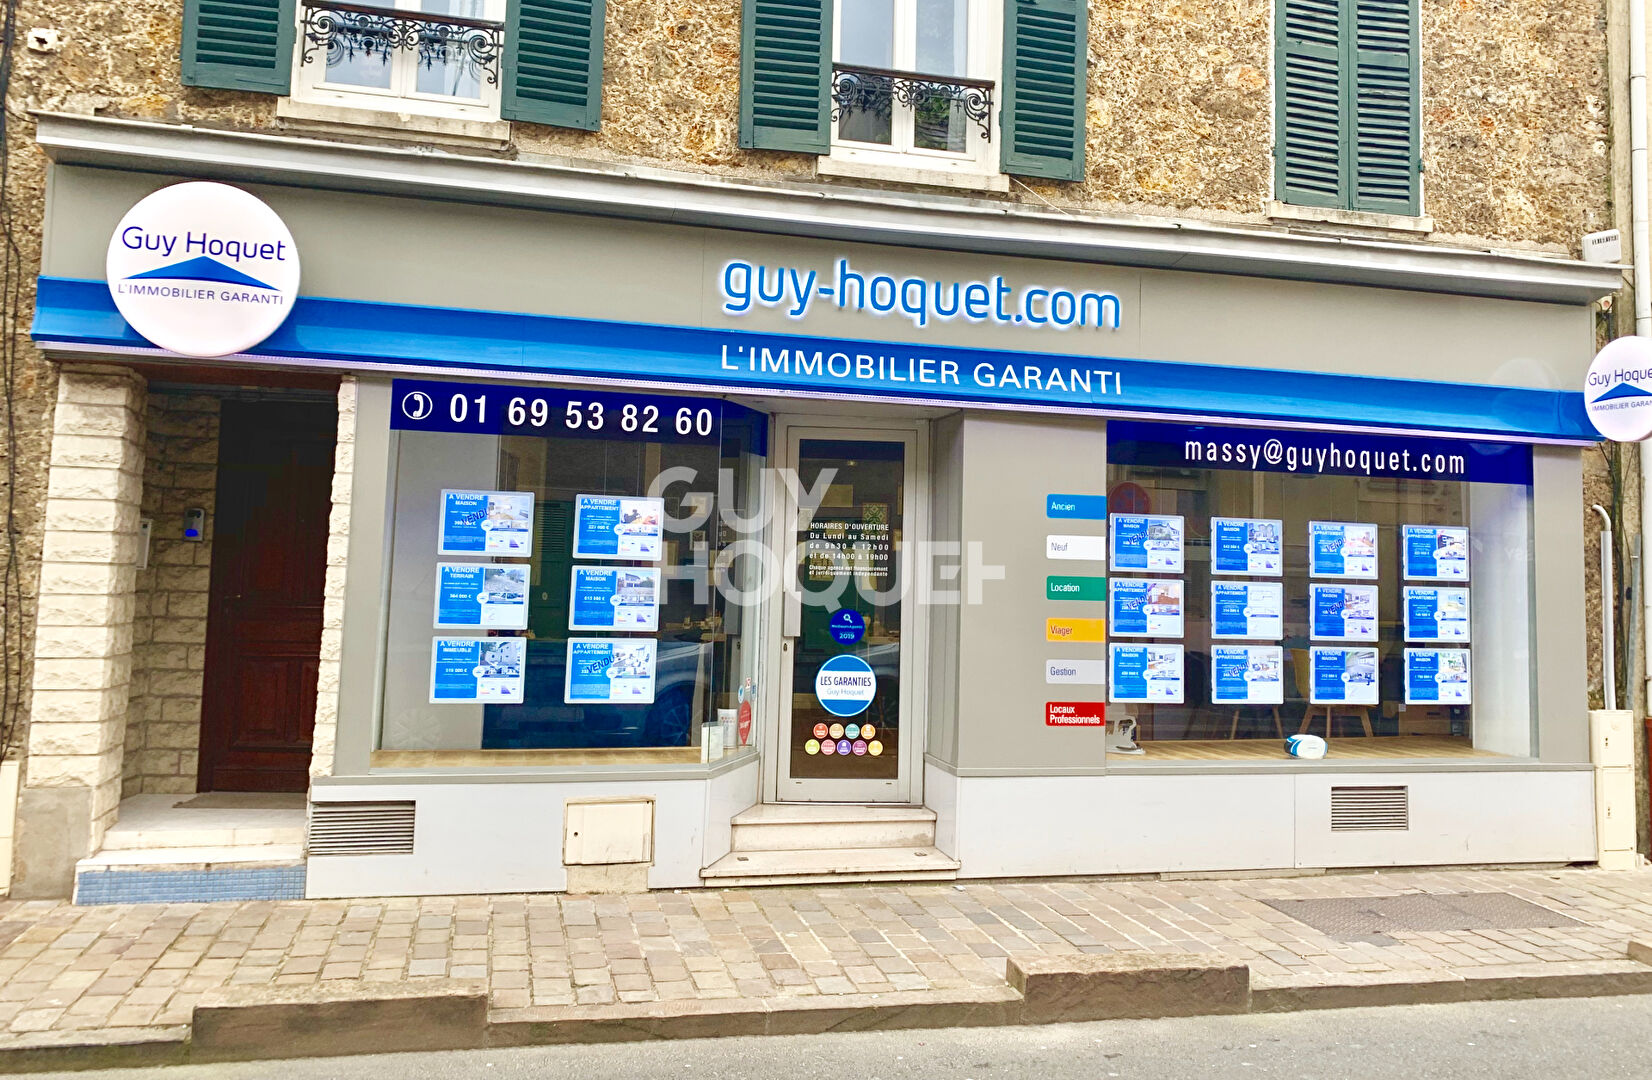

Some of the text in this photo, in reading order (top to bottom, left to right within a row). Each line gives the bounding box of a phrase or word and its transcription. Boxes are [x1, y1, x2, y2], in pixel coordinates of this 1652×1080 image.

[121, 226, 286, 262] Guy Hoquet
[118, 284, 284, 305] L'IMMOBILIER GARANTI
[724, 260, 1121, 328] guy-hoquet.com
[721, 344, 1122, 395] L'IMMOBILIER GARANTI
[1588, 372, 1611, 387] Guy
[449, 393, 713, 436] 01 69 53 82 60
[1185, 438, 1465, 475] massy@guyhoquet.com
[1051, 501, 1075, 511] Ancien
[810, 522, 889, 531] HORAIRES D'OUVERTURE
[1051, 542, 1068, 551] Neuf
[866, 553, 889, 561] 19h00
[1050, 583, 1080, 593] Location
[1050, 625, 1073, 636] Viager
[1050, 666, 1077, 676] Gestion
[820, 676, 872, 687] LES GARANTIES
[827, 688, 864, 697] Guy Hoquet
[1050, 704, 1075, 714] Locaux
[1050, 715, 1100, 724] Professionnels
